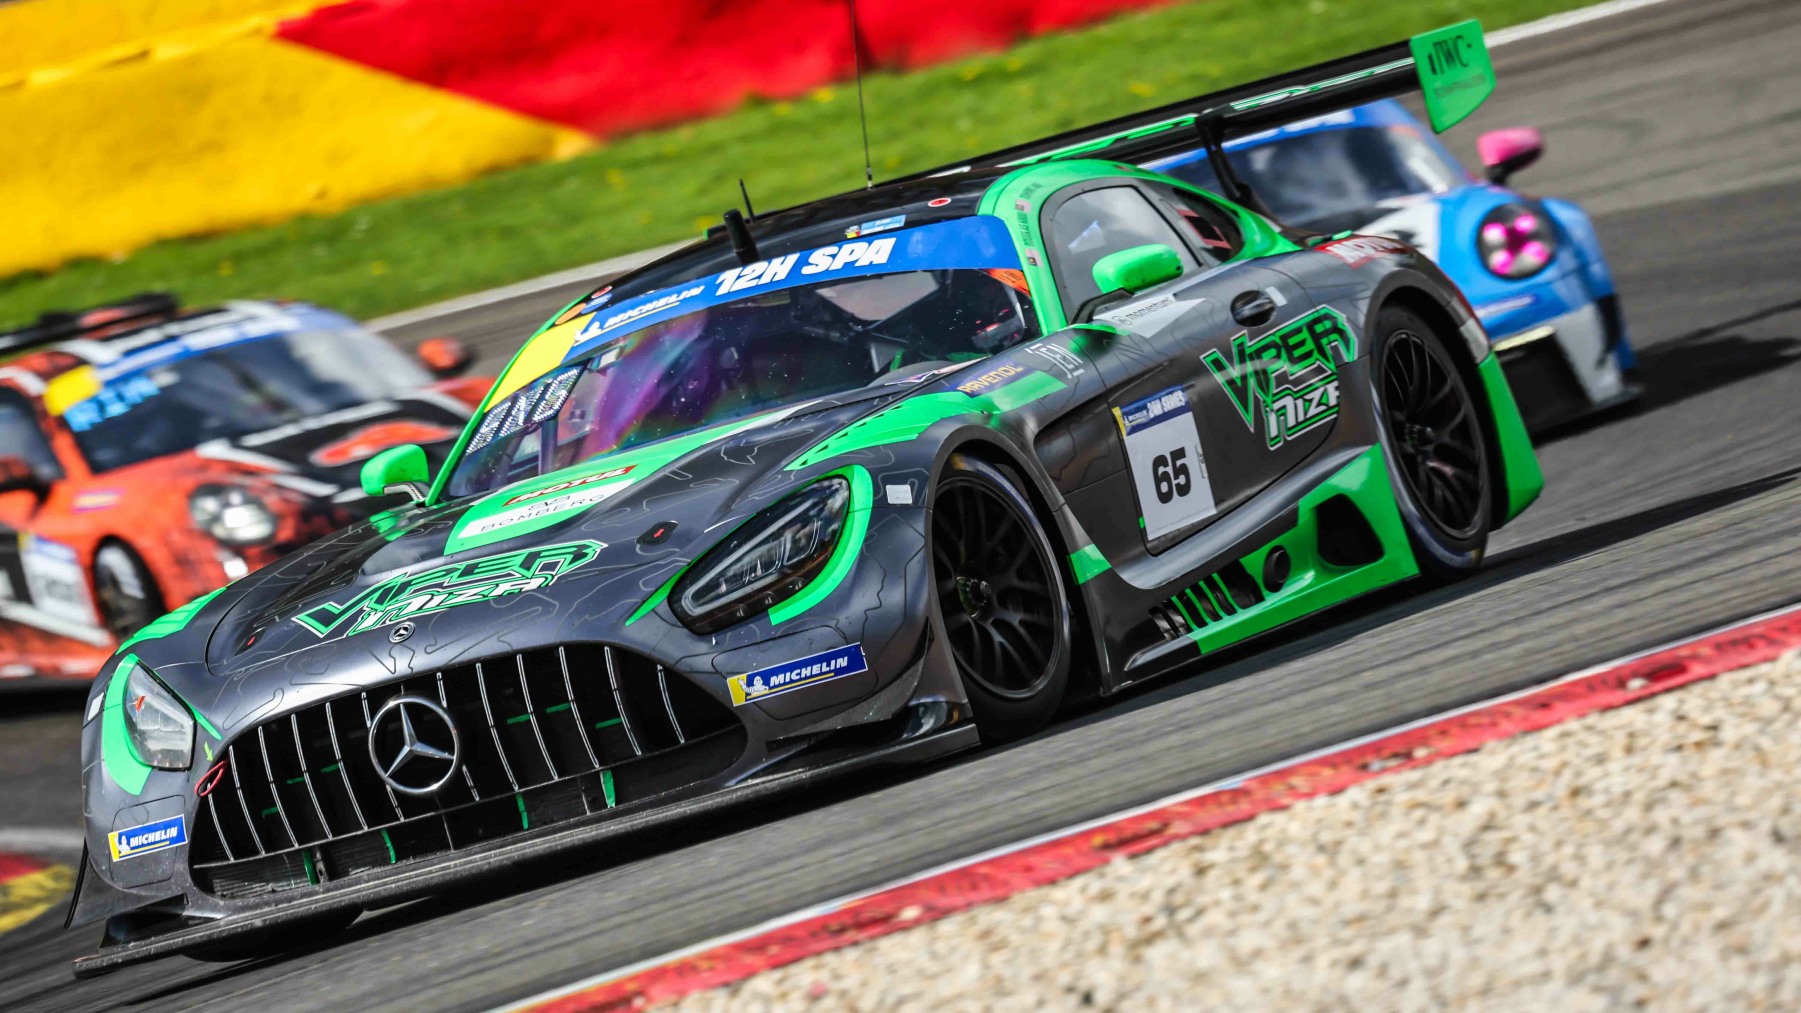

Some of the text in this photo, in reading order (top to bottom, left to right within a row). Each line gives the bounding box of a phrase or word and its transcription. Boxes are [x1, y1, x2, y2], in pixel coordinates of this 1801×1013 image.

[604, 285, 705, 328] MICHELIN
[715, 252, 802, 296] 12H
[801, 236, 896, 275] SPA
[956, 363, 1023, 394] RAVENOL
[1152, 446, 1191, 504] 65
[769, 656, 848, 687] MICHELIN
[130, 826, 178, 848] MICHELIN
